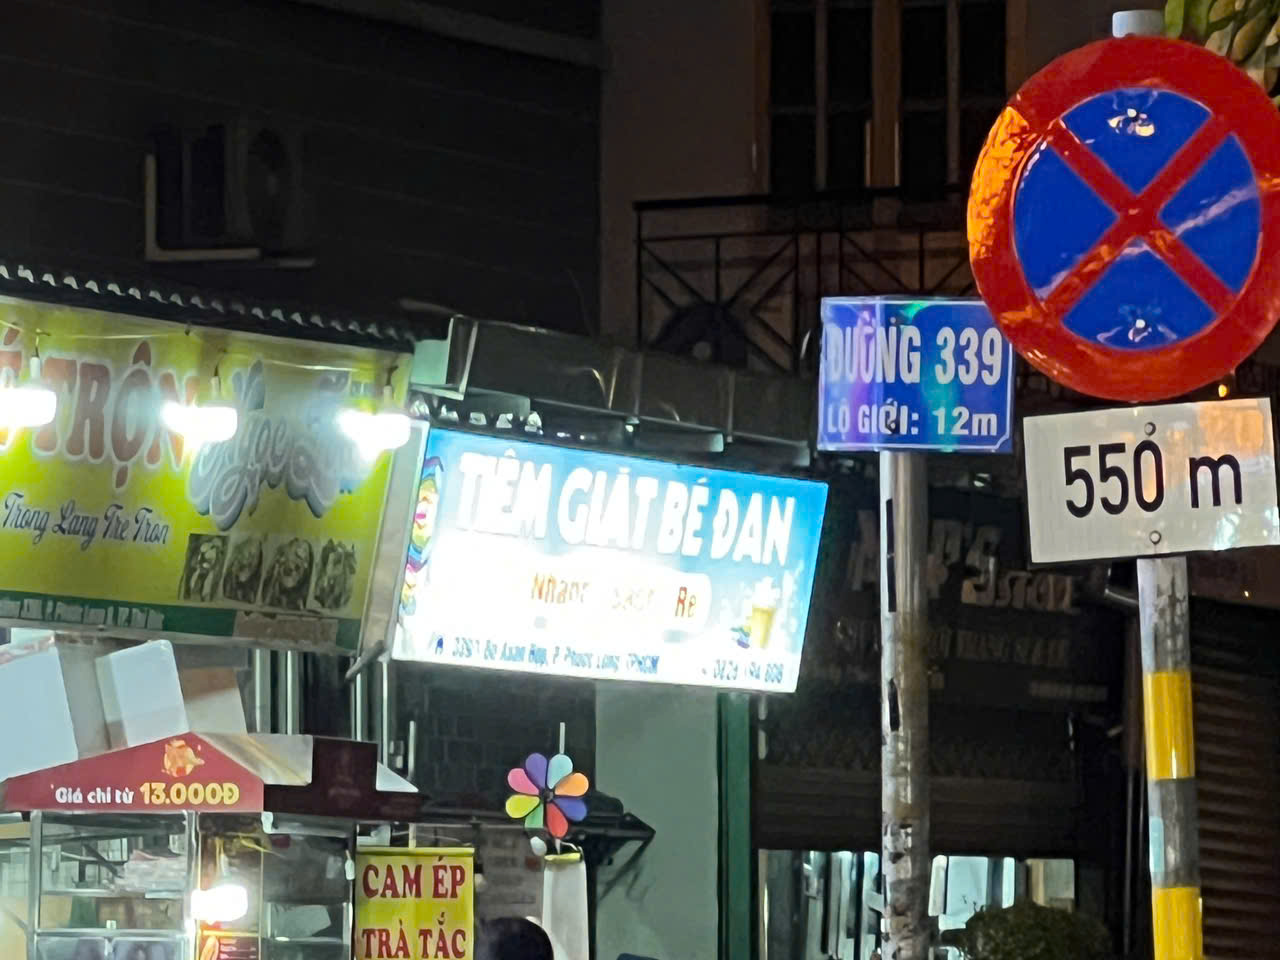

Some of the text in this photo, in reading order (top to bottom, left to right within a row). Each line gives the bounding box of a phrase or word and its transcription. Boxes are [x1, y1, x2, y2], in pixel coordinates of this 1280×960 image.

[935, 326, 1003, 386] 339
[932, 406, 998, 437] 12m
[1063, 439, 1243, 519] 550 m
[656, 477, 710, 556] BÉ
[55, 787, 83, 804] Giá
[140, 782, 240, 806] 13.000Đ
[362, 856, 466, 899] CAM ÉP
[361, 911, 467, 960] TRÀ TẮC
